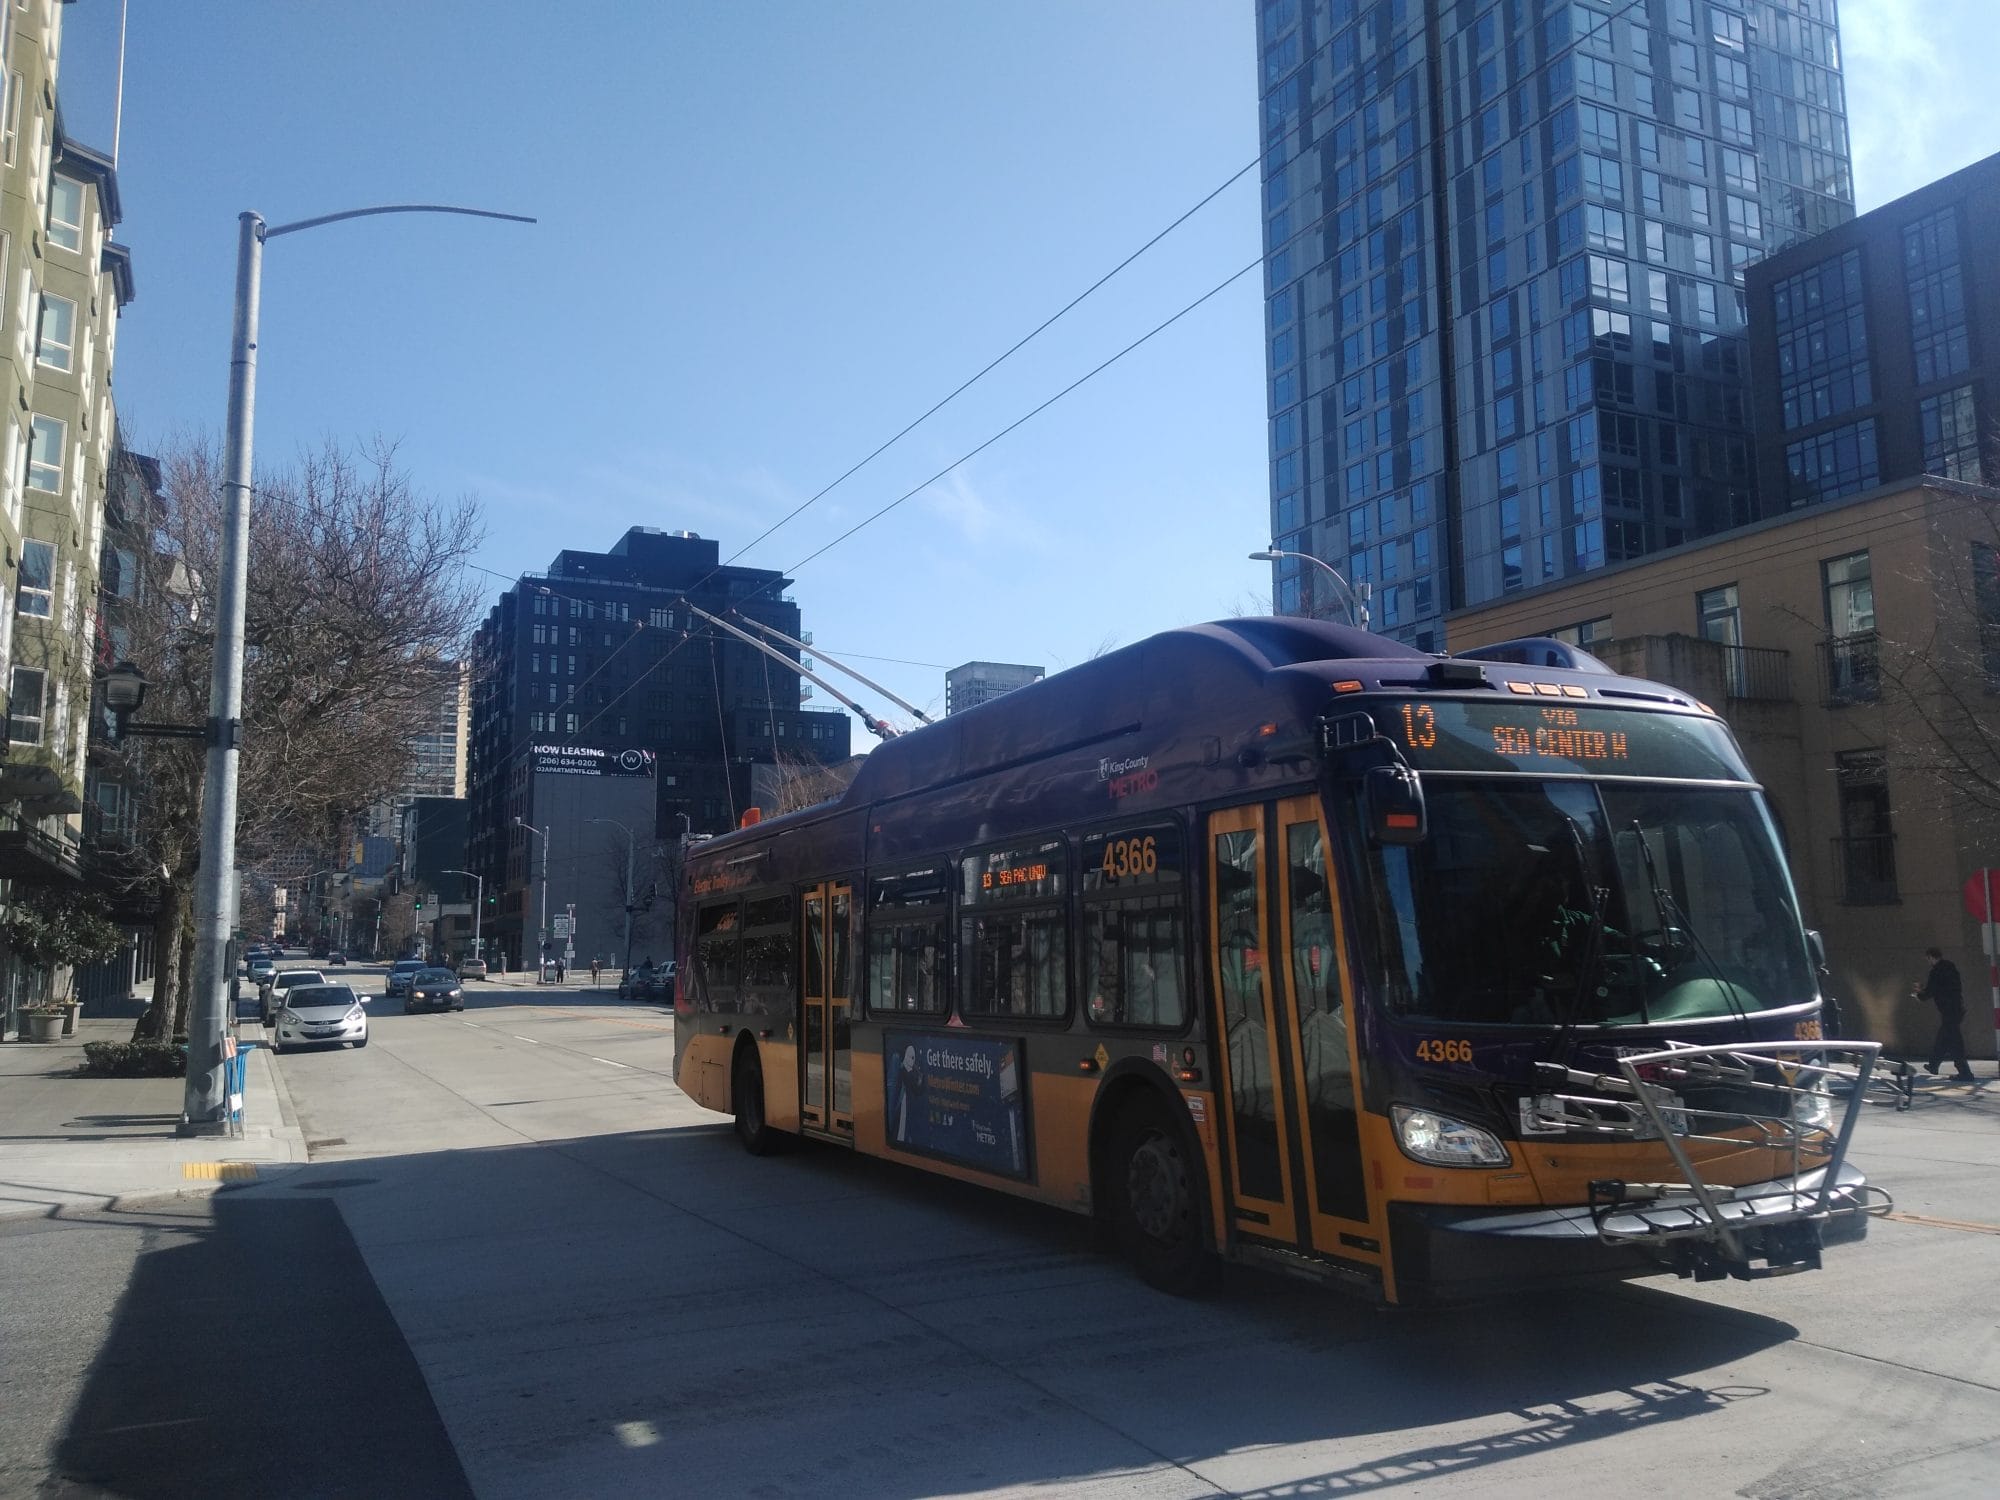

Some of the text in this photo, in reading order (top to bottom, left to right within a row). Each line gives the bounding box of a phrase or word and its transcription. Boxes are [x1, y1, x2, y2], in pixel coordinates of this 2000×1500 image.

[1401, 704, 1436, 749] 13
[1541, 708, 1578, 725] VIA
[534, 745, 605, 757] NOW LEASING
[1492, 726, 1531, 755] SEA
[1535, 727, 1608, 758] CENTER
[539, 756, 597, 767] (206) 634-0202
[1109, 755, 1149, 774] King County
[1109, 769, 1158, 799] METRO
[1102, 836, 1157, 878] 4366
[983, 873, 992, 888] 13
[999, 869, 1012, 886] SEA
[1013, 867, 1028, 883] PAC
[1416, 1039, 1473, 1062] 4366
[927, 1048, 994, 1079] Get there safely.
